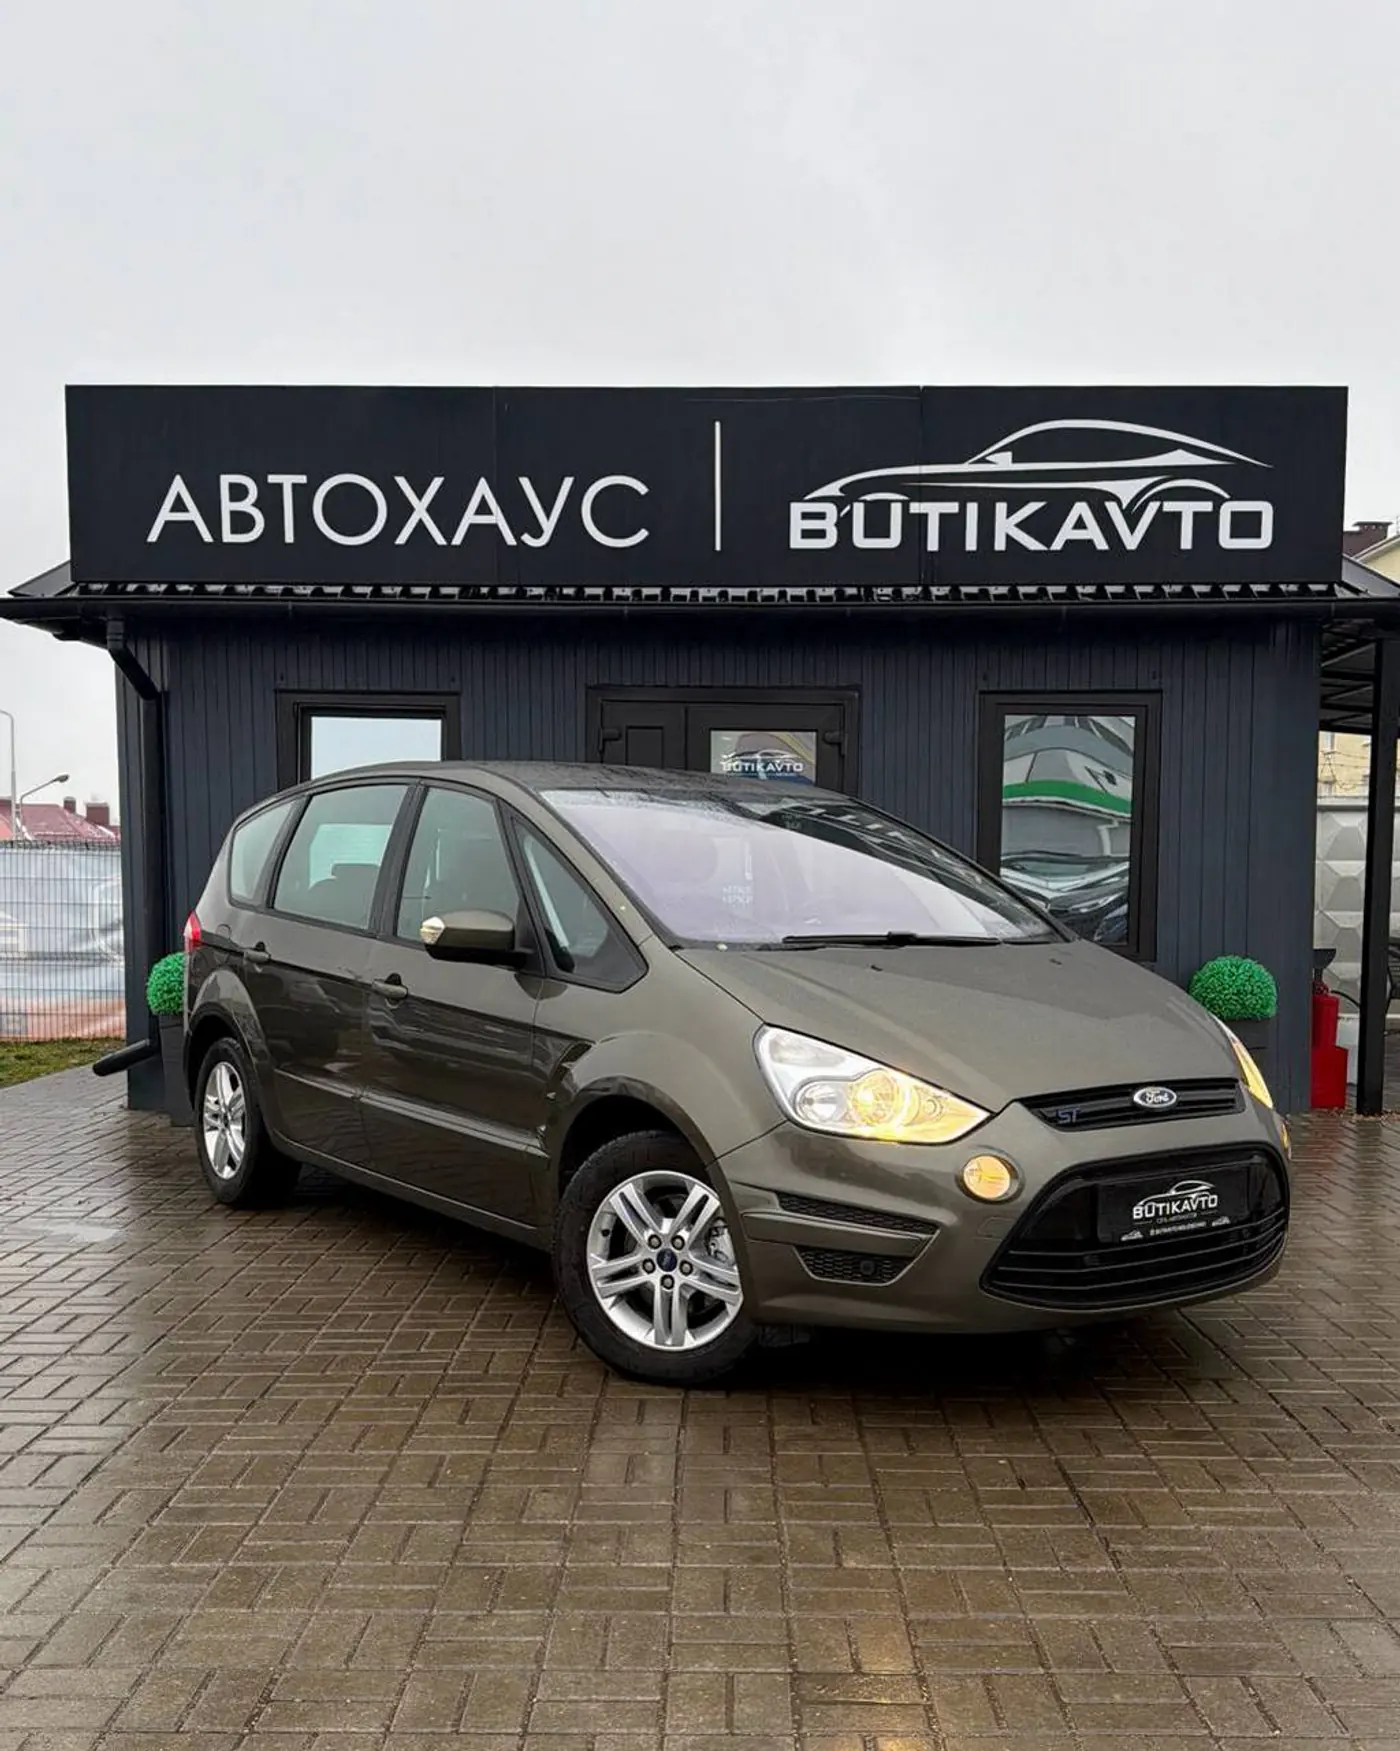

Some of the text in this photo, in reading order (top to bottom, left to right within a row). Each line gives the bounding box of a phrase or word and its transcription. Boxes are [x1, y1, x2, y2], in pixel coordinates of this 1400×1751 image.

[146, 473, 650, 547] АВТОХАУС
[789, 500, 1274, 551] BUTIKAVTO
[1133, 1194, 1219, 1220] BUTIKAVTO
